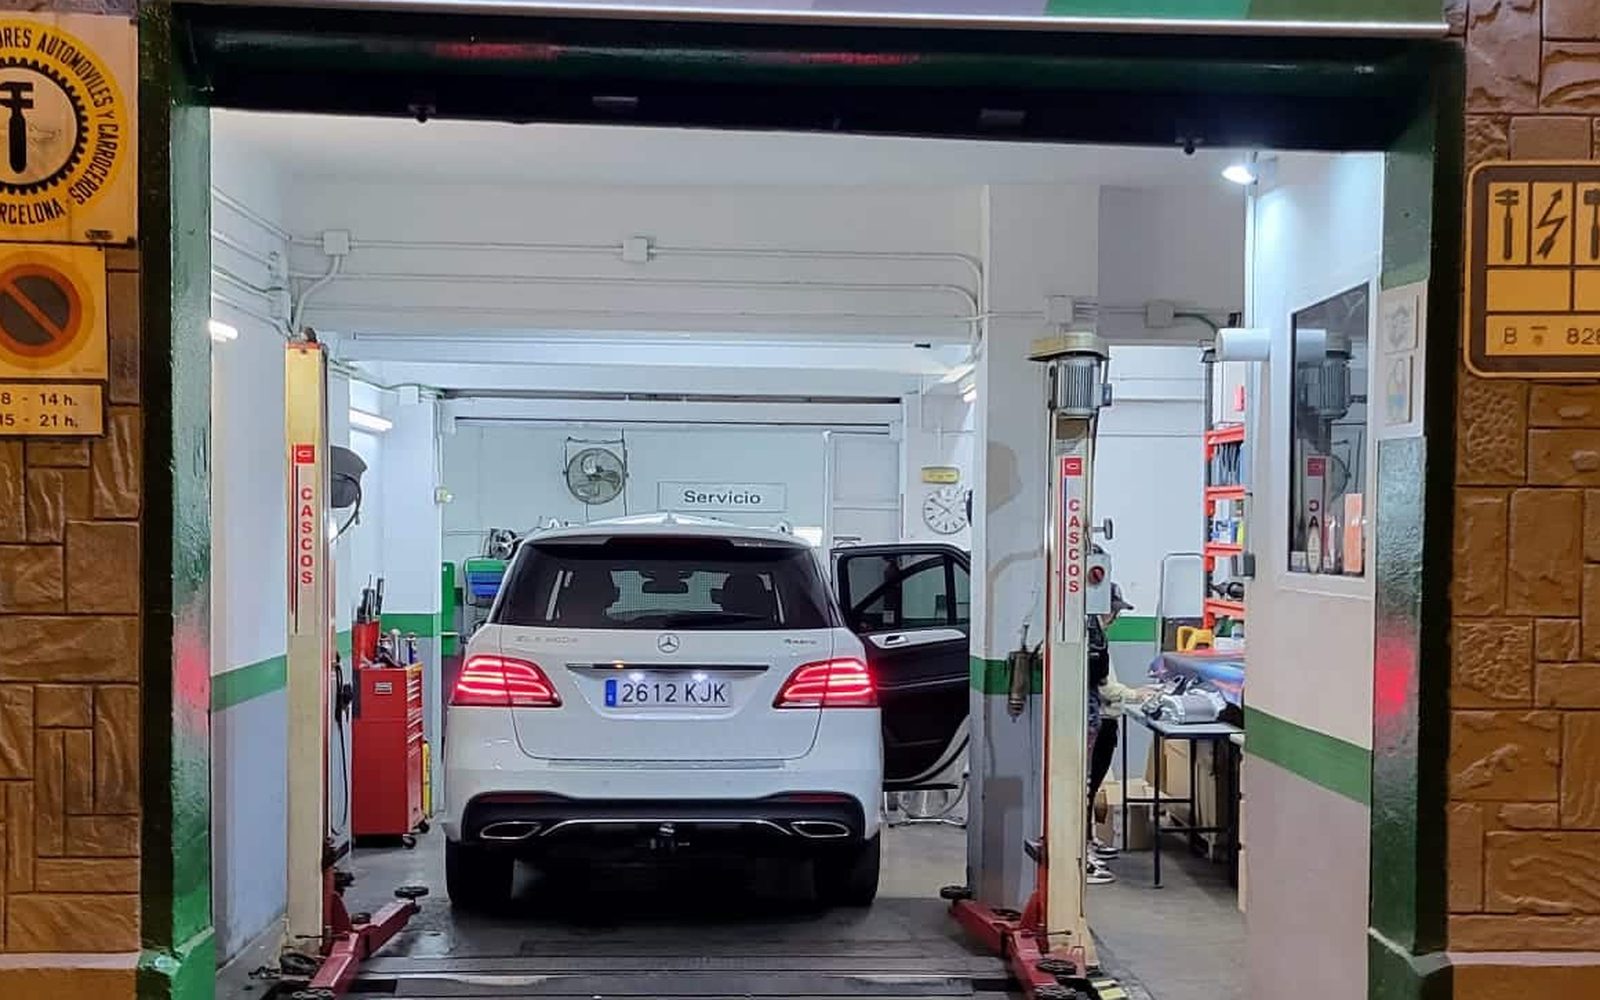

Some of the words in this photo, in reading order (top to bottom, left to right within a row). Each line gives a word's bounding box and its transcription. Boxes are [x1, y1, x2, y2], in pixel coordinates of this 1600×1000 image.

[36, 32, 114, 108] AUTOMOVILES
[96, 110, 115, 120] Y
[68, 123, 119, 206] CARROCEROS
[1, 392, 11, 405] 8
[39, 393, 58, 406] 14
[40, 414, 58, 427] 21
[683, 490, 762, 505] Servicio
[300, 487, 313, 584] CASCOS
[1068, 499, 1080, 593] CASCOS
[622, 683, 677, 702] 2612
[685, 683, 726, 702] KJK
